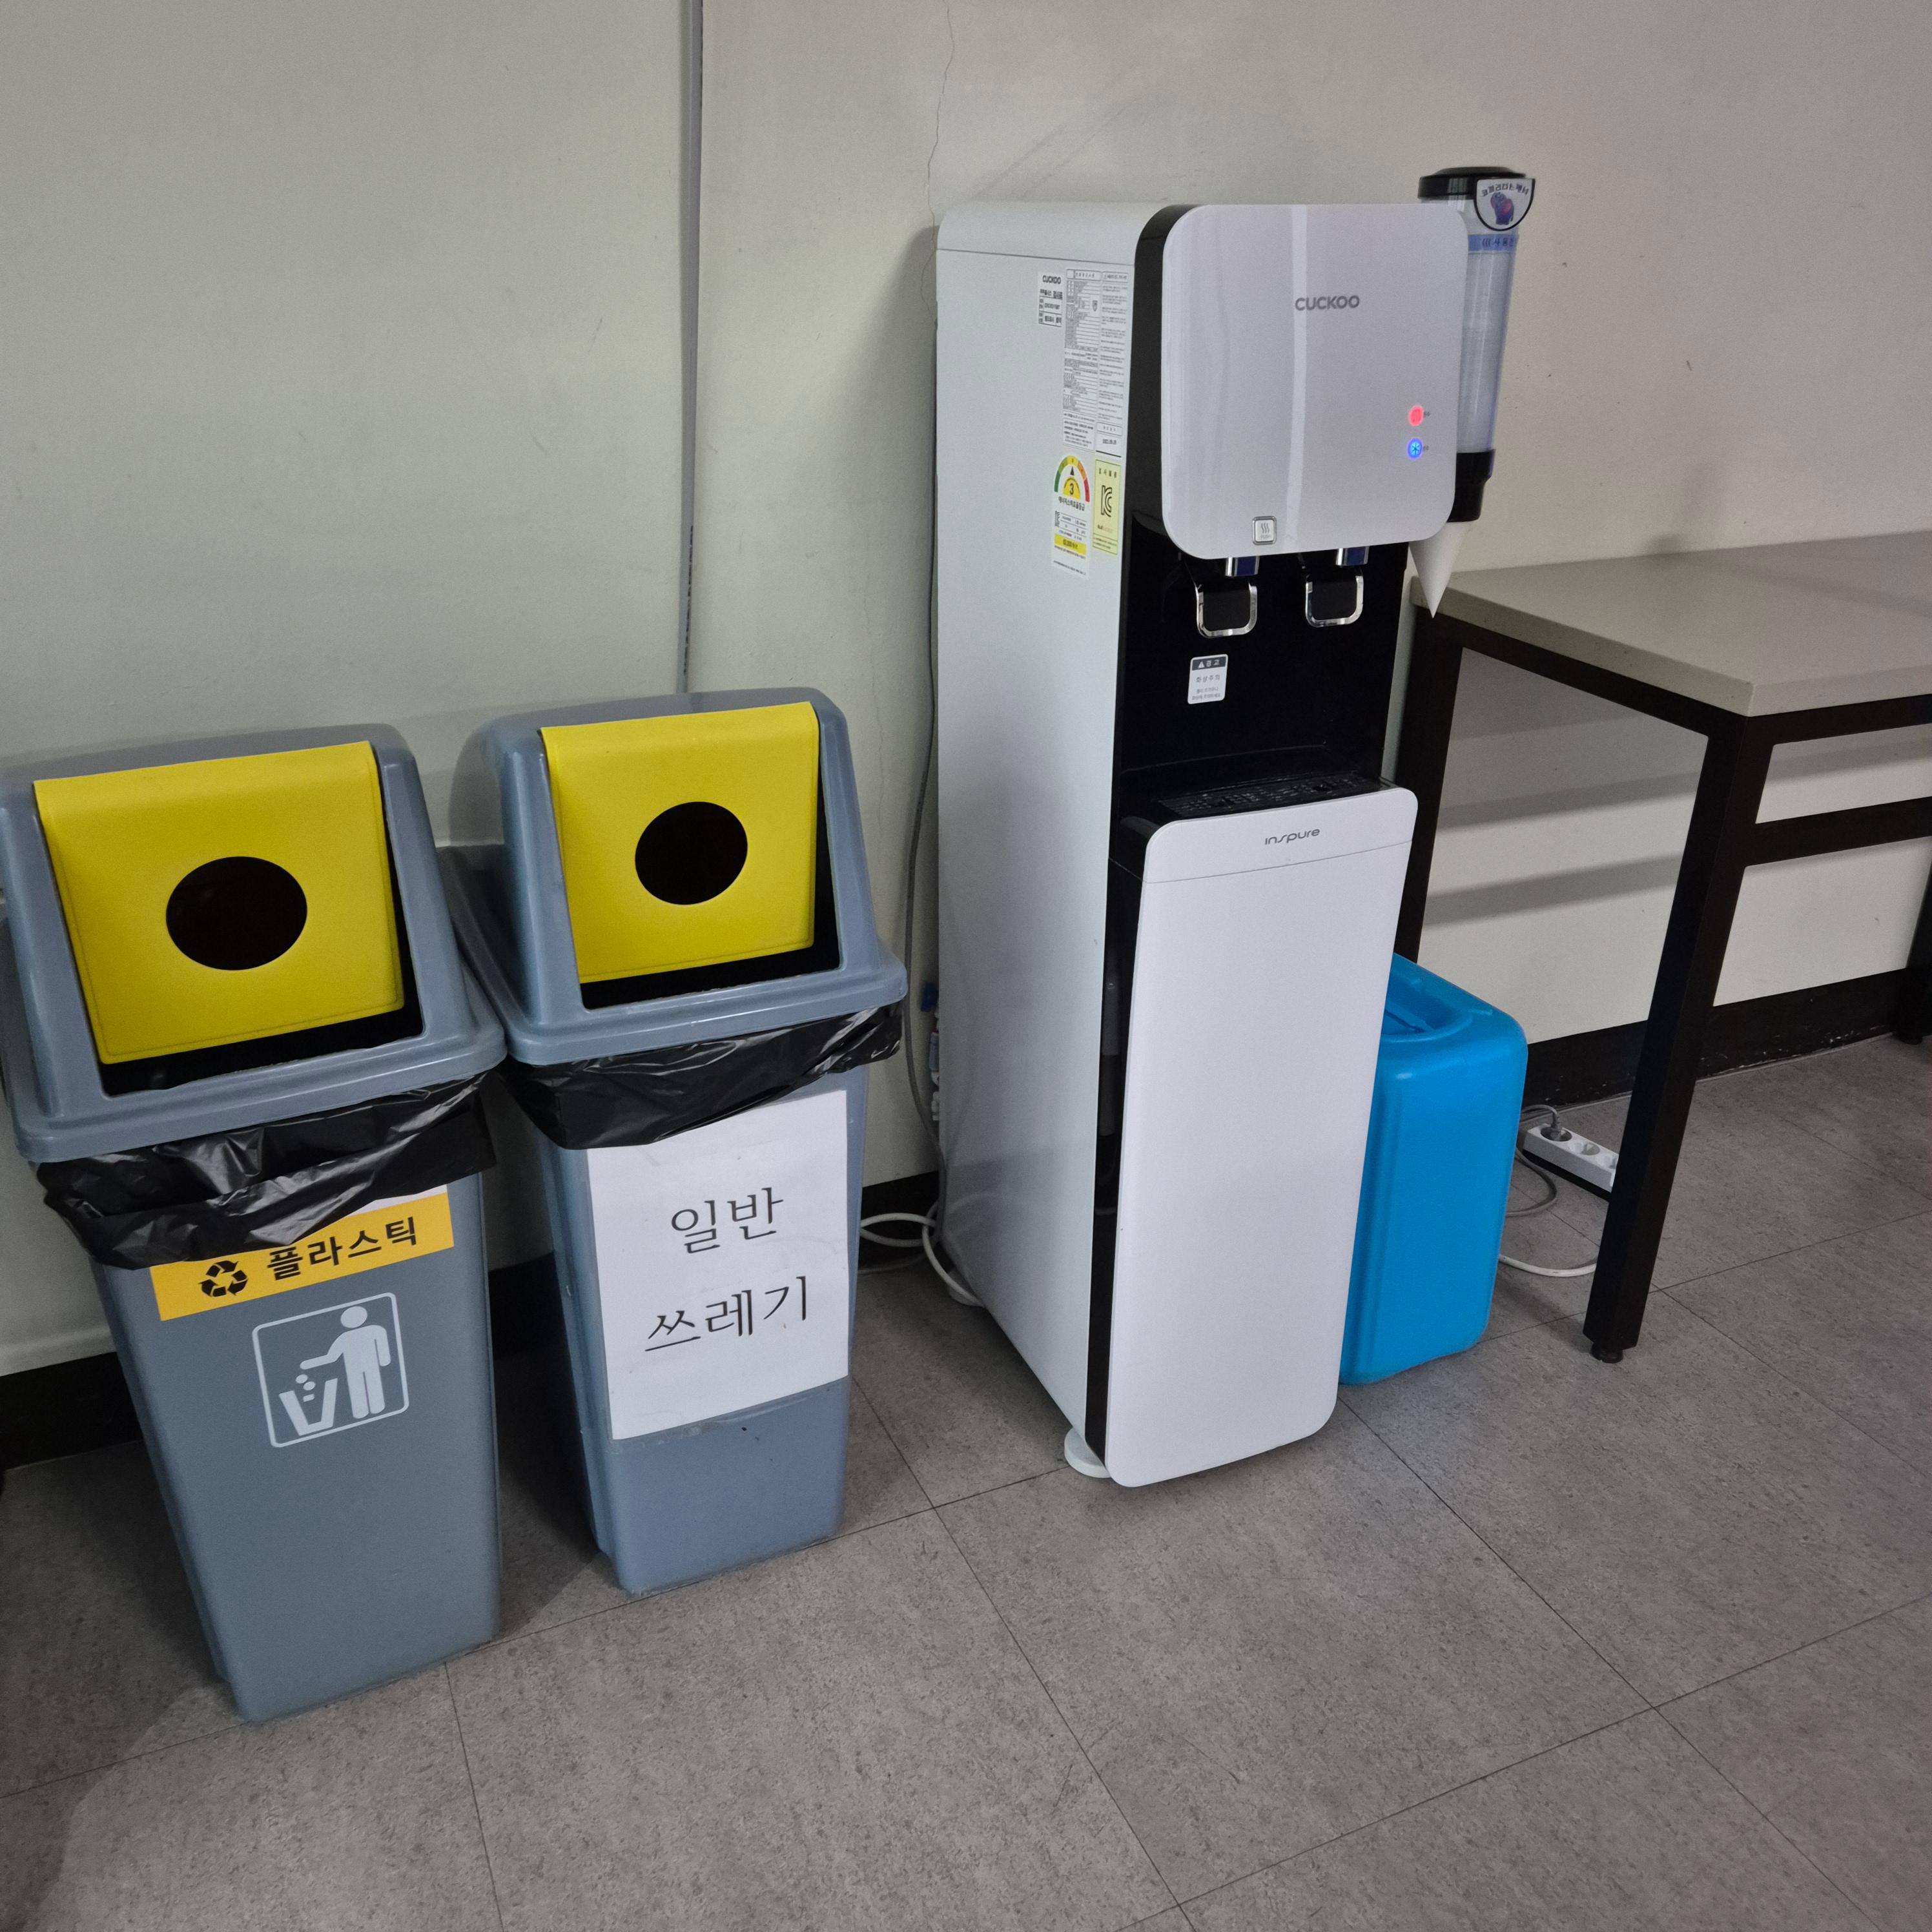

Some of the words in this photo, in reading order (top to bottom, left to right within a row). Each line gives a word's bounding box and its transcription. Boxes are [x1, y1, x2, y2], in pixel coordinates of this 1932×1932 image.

[1042, 274, 1062, 285] CUCKOO
[1295, 295, 1360, 311] CUCKOO
[1069, 483, 1074, 495] 3
[1265, 828, 1321, 845] inspure
[671, 1187, 784, 1254] 일반
[267, 1216, 416, 1280] 플라스틱
[644, 1275, 807, 1352] 쓰레기
